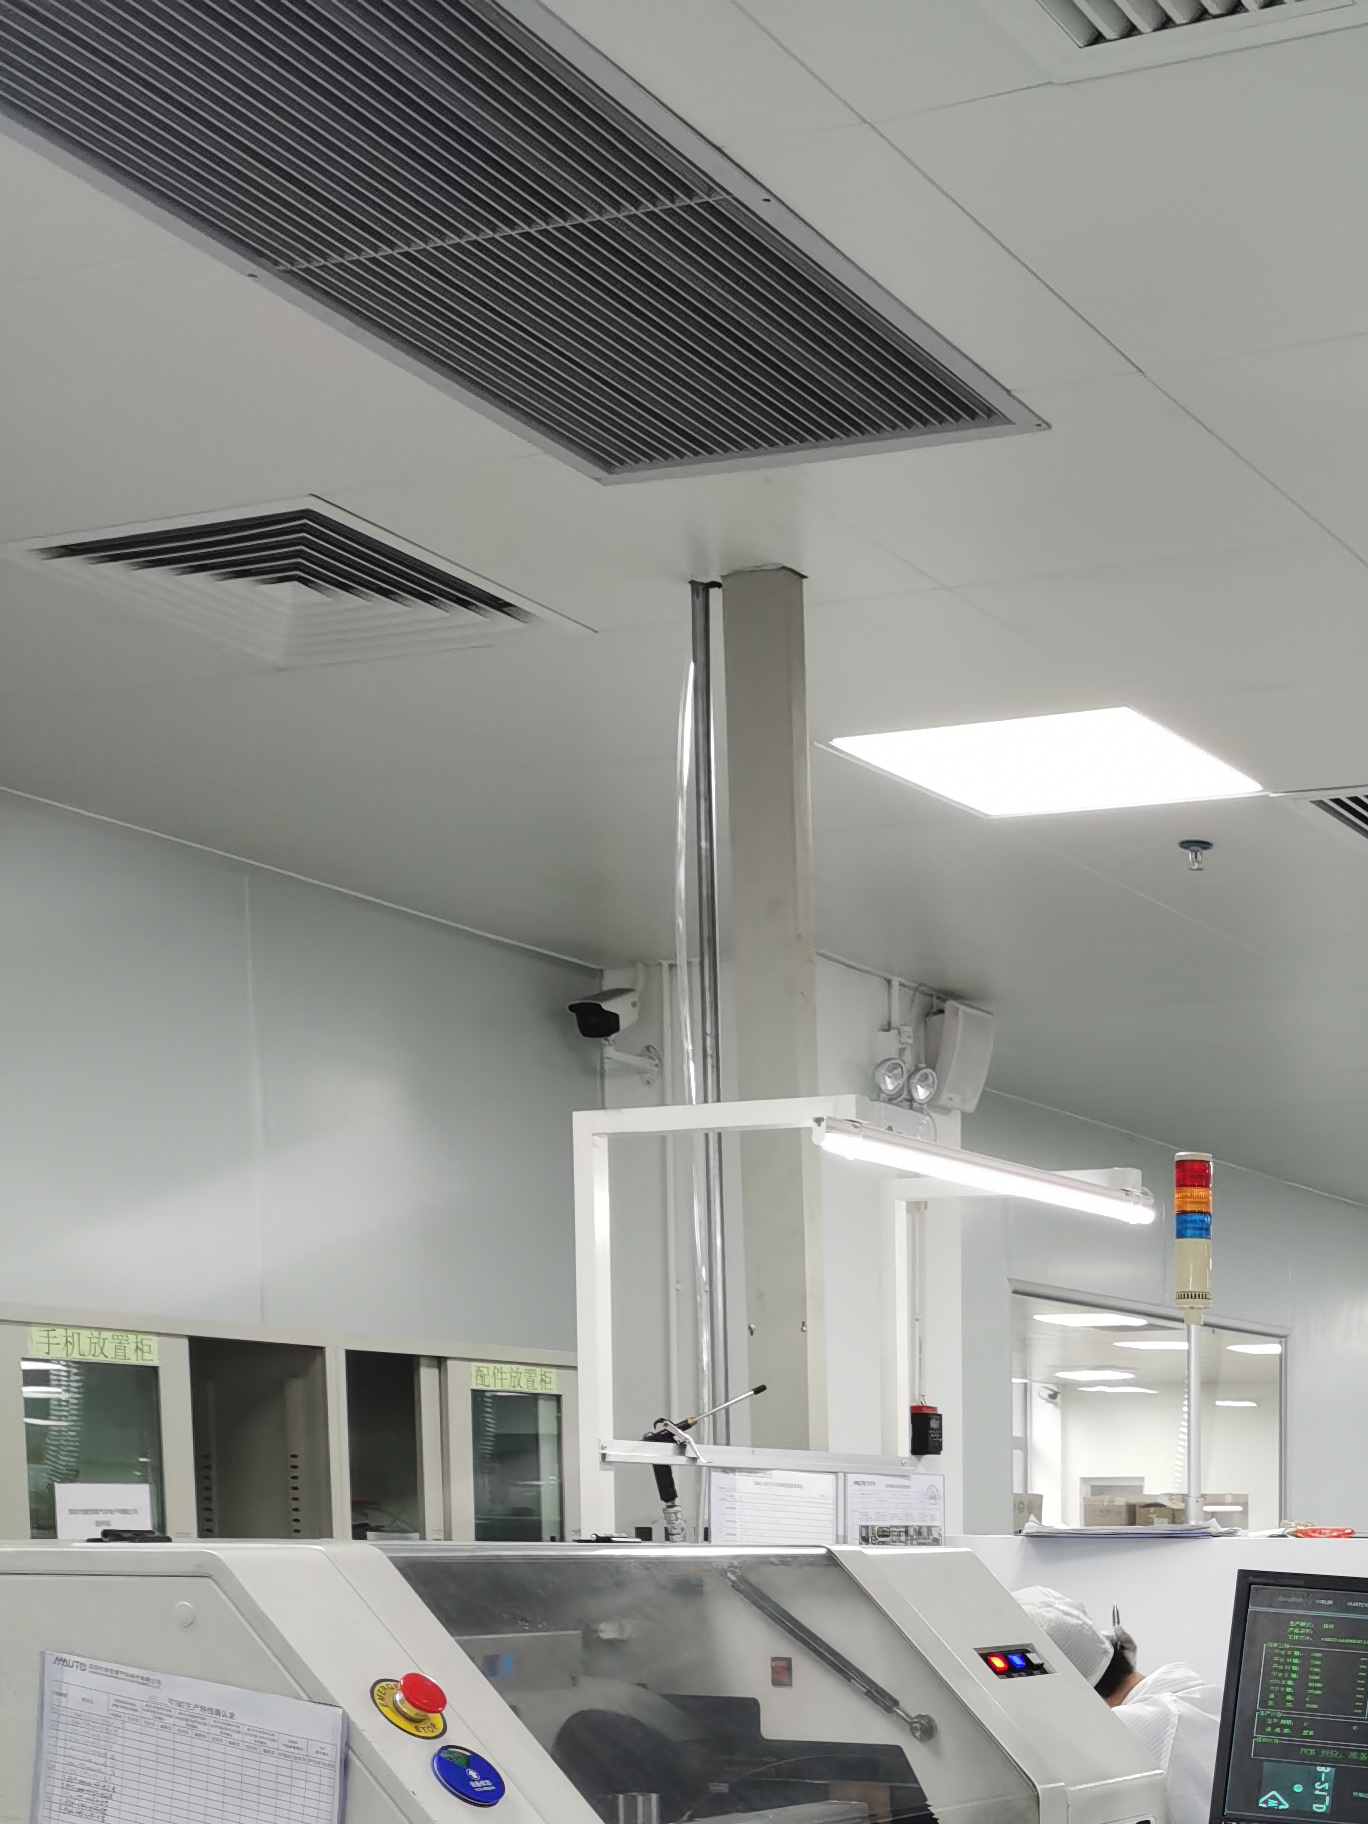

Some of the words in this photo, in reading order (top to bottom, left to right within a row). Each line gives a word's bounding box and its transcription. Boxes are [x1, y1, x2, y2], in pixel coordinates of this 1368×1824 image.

[36, 1328, 155, 1362] 手机放置柜
[474, 1365, 554, 1391] 配件放置柜
[377, 1683, 401, 1708] EMERGE
[414, 1722, 438, 1735] STOP
